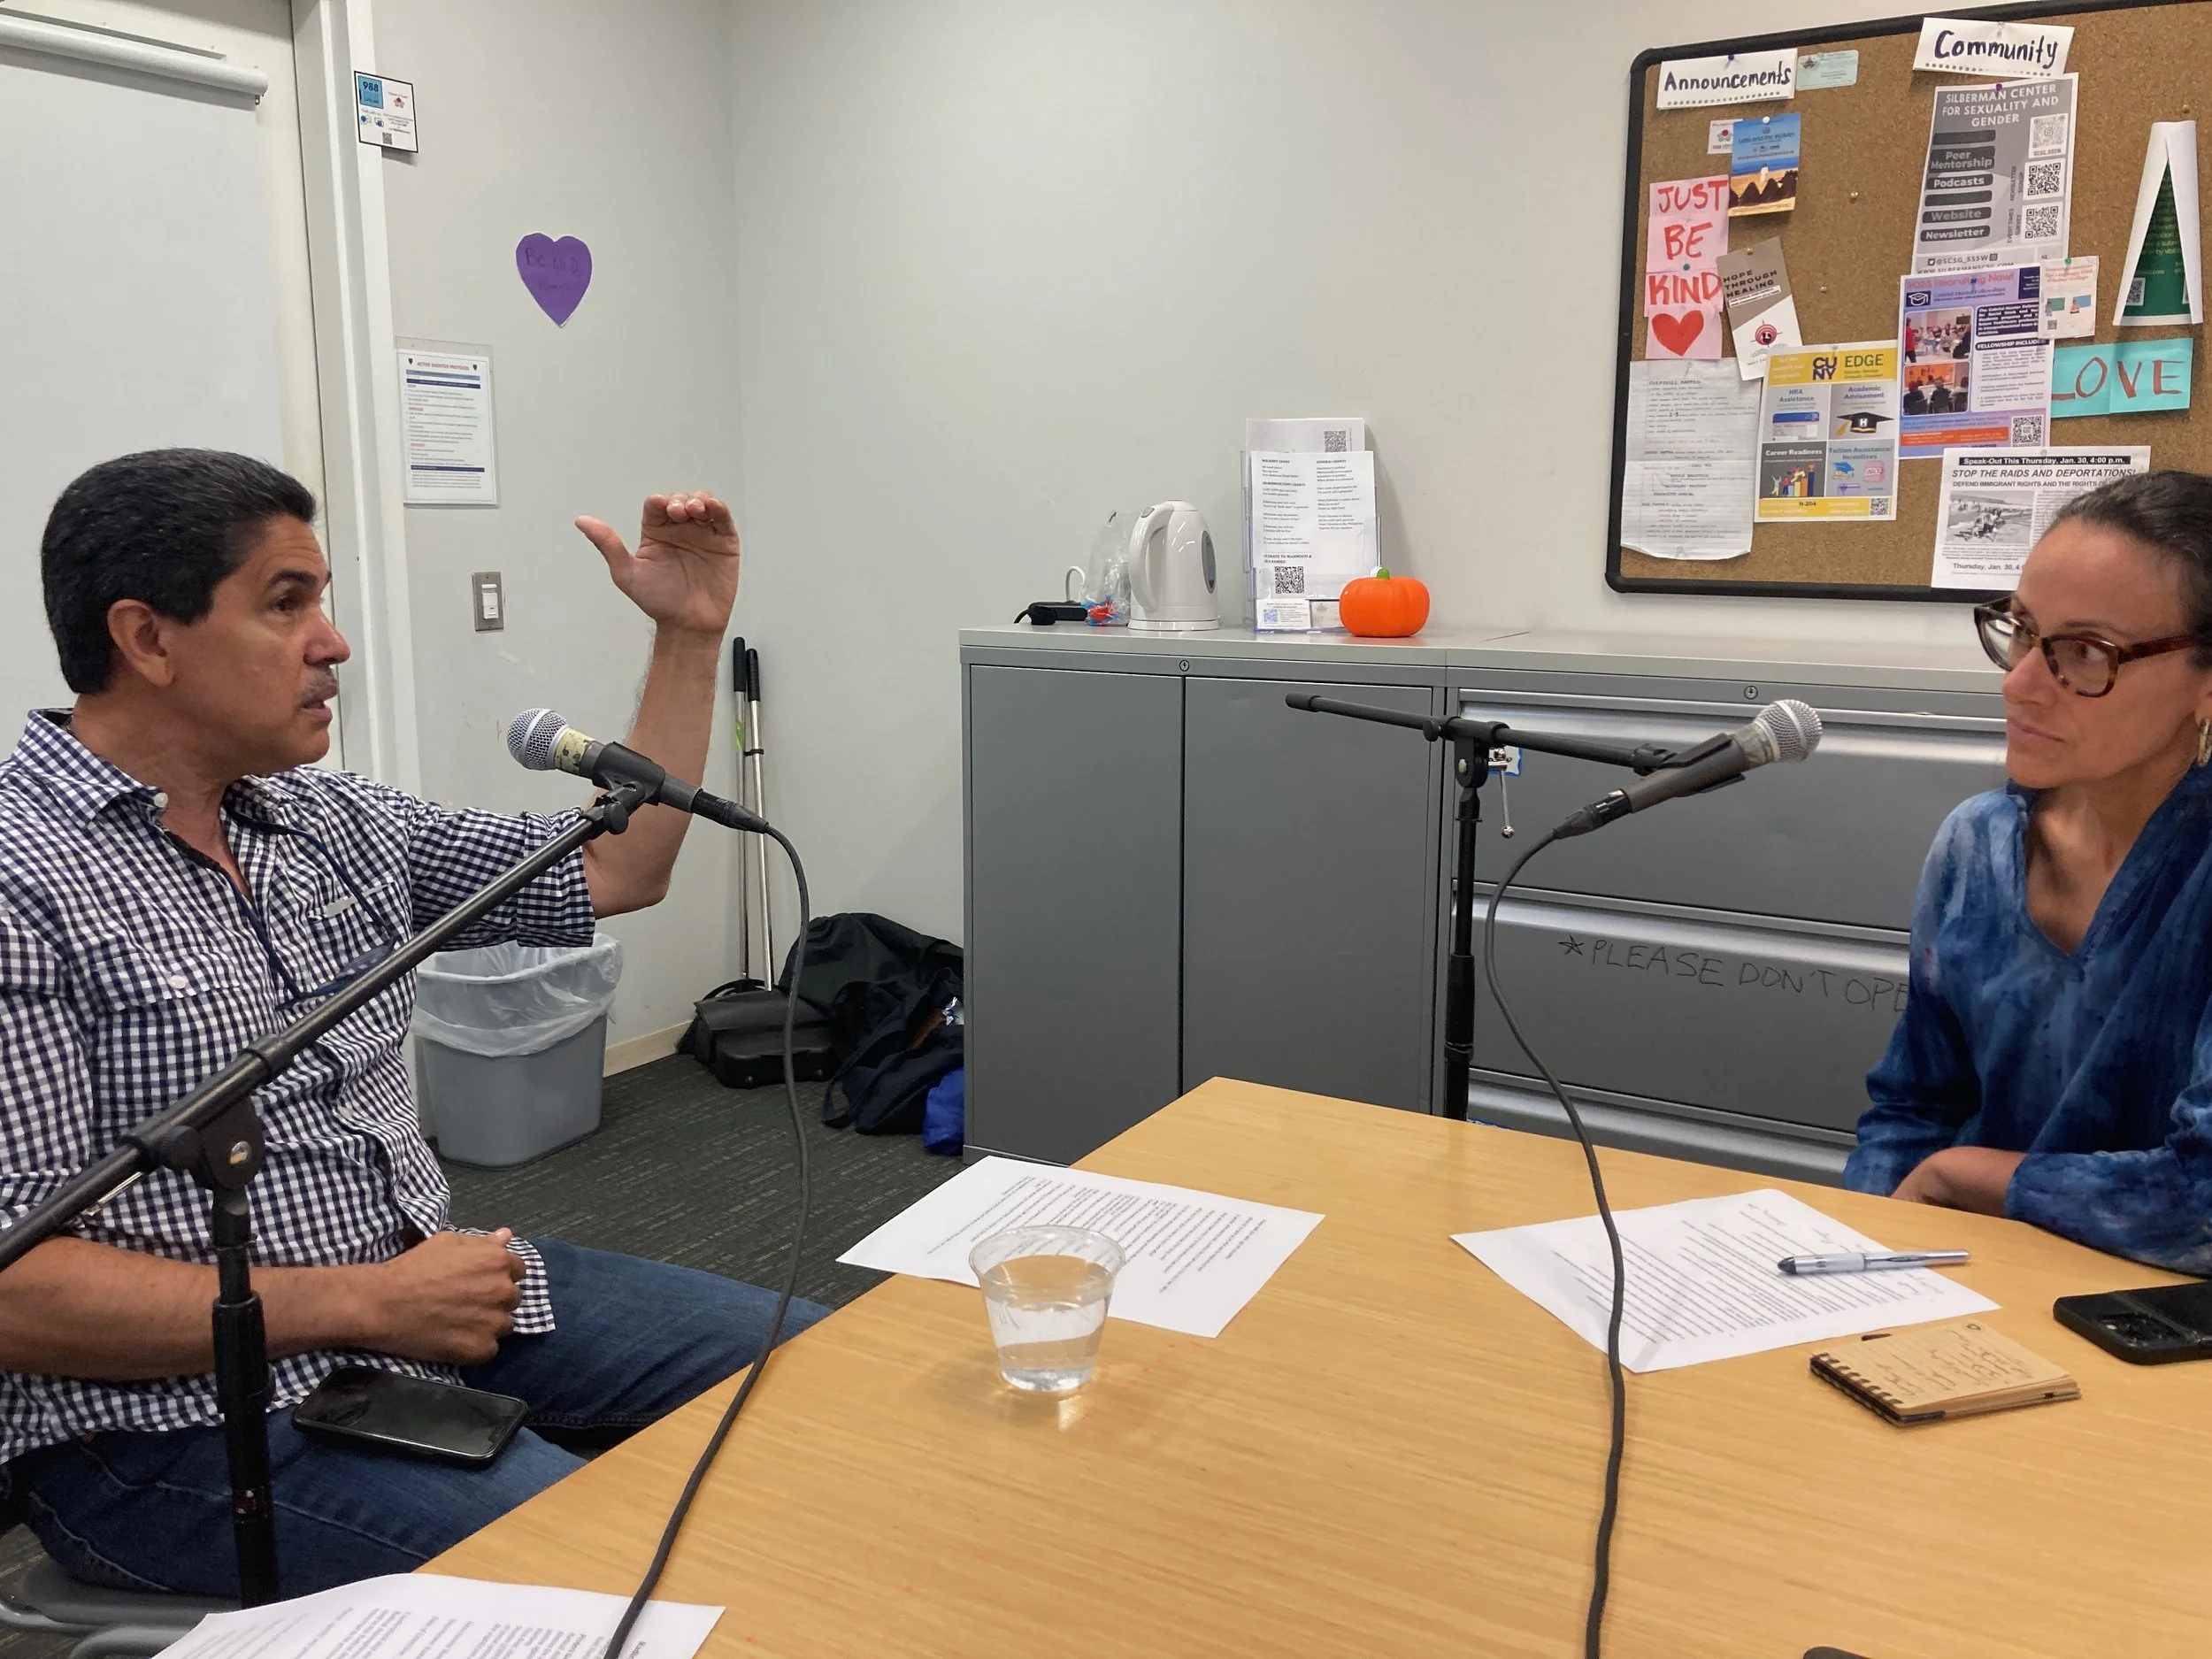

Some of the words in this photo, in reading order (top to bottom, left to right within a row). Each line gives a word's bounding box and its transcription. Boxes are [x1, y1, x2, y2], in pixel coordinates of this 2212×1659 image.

[1934, 30, 2058, 69] Community
[1664, 61, 1792, 91] Announcements
[363, 81, 379, 92] 988
[1946, 90, 2007, 104] SILBERMAN
[2010, 83, 2056, 98] CENTER
[1942, 104, 1961, 117] FOR
[1963, 99, 2028, 115] SEXUALITY
[2032, 96, 2059, 107] AND
[1971, 113, 2019, 127] GENDER
[1946, 151, 1971, 160] Peer
[1931, 158, 1993, 170] Mentorship
[1933, 177, 1985, 188] Podcasts
[1657, 180, 1728, 213] JUST
[1931, 209, 1982, 221] Website
[1663, 221, 1713, 260] BE
[1925, 228, 1985, 240] Newsletter
[1723, 270, 1753, 282] HOPE
[1724, 270, 1778, 290] THROUGH
[1934, 276, 1985, 288] Recruitng
[1988, 271, 2014, 281] Now!
[1649, 272, 1723, 305] KIND
[1726, 280, 1774, 298] HEALING
[1977, 341, 2015, 349] FELLOWSHIP
[1812, 356, 1838, 369] CU
[1845, 354, 1884, 368] EDGE
[1812, 368, 1836, 380] NY
[1860, 418, 1868, 427] H
[1952, 469, 1978, 478] STOP
[1979, 469, 1999, 478] THE
[2000, 469, 2030, 478] RAIDS
[2032, 469, 2053, 478] AND
[1593, 938, 1725, 987] PLEASE
[1738, 961, 1837, 998] DON'T
[1845, 976, 1909, 1012] OPE
